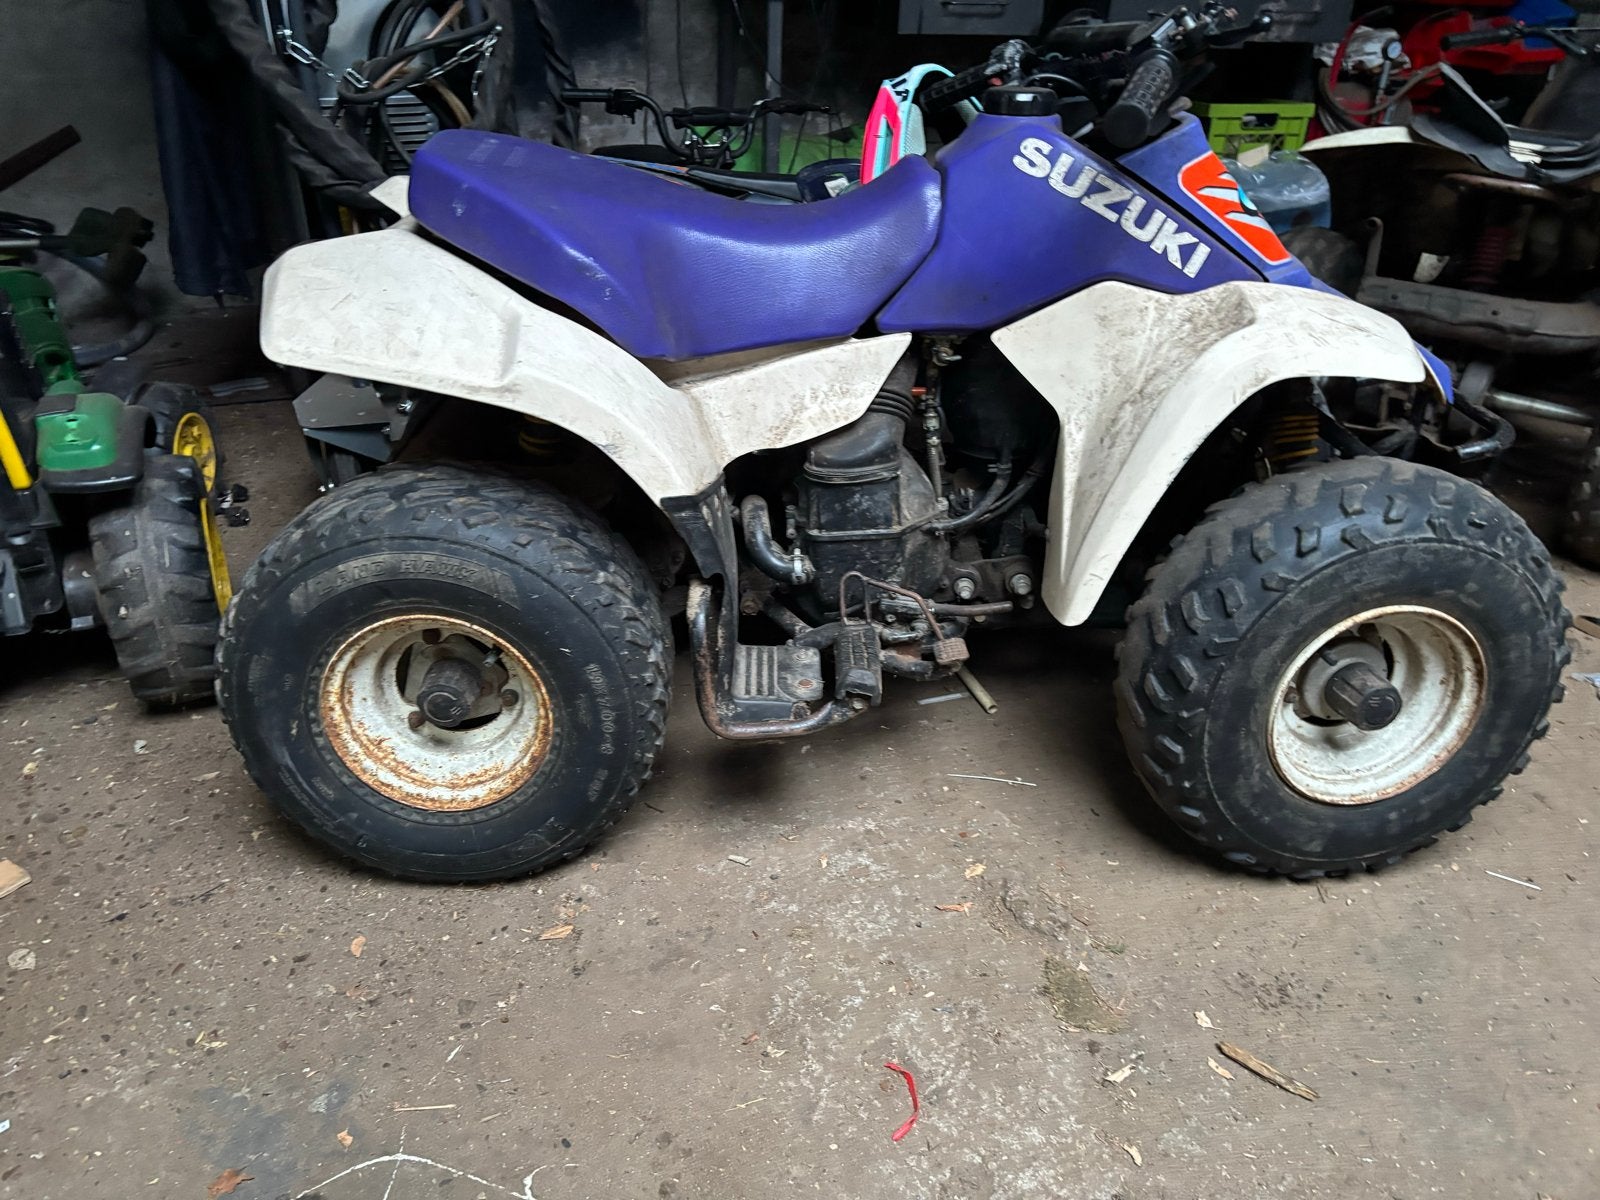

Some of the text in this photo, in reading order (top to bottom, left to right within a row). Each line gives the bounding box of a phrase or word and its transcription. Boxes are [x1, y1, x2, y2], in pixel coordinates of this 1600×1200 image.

[1012, 137, 1212, 279] SUZUKI
[316, 559, 477, 596] LAND HAWK
